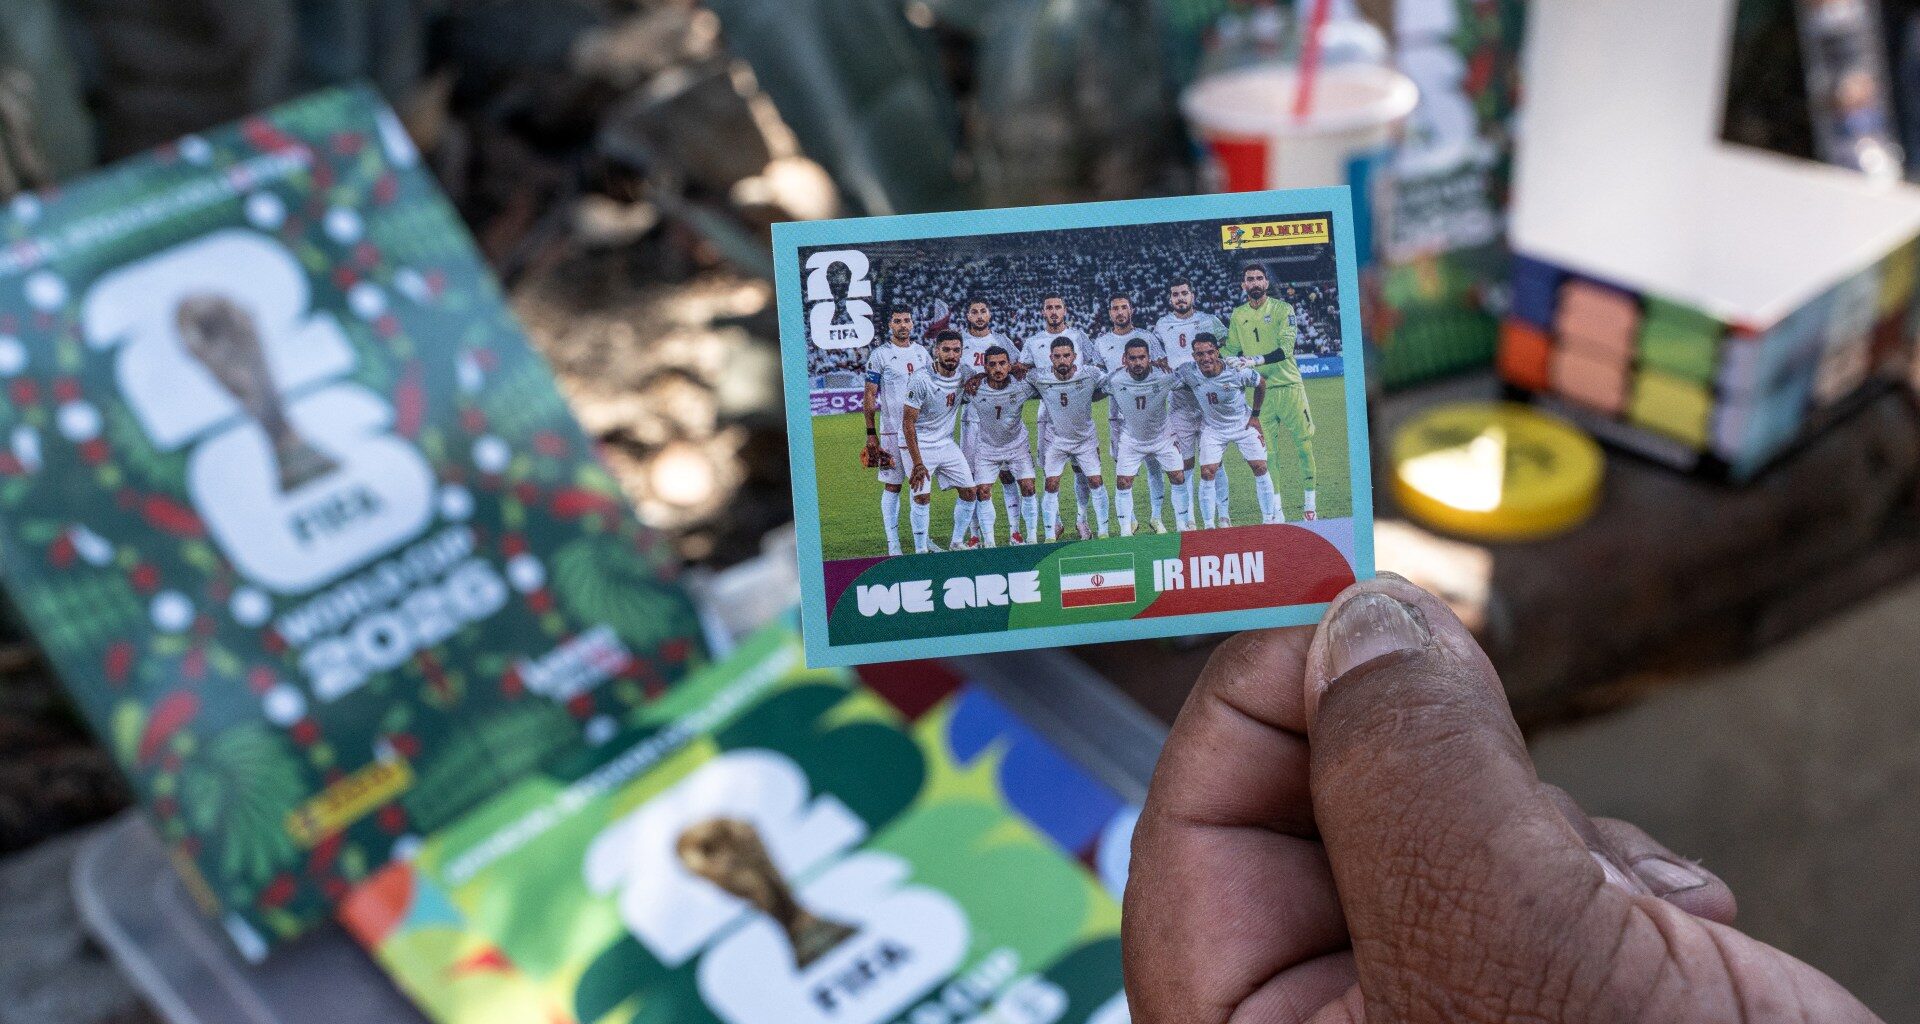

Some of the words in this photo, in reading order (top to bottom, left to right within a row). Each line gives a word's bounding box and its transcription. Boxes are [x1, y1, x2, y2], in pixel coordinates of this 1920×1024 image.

[1252, 222, 1324, 239] PANINI
[829, 328, 859, 341] FIFA
[1179, 333, 1187, 348] 6
[1253, 327, 1260, 342] 1
[1060, 392, 1068, 407] 5
[1135, 395, 1147, 410] 17
[1205, 391, 1219, 405] 18
[994, 405, 1003, 420] 7
[1153, 558, 1184, 592] IR
[1190, 551, 1265, 588] IRAN
[856, 579, 935, 617] WE
[302, 557, 508, 700] 2026
